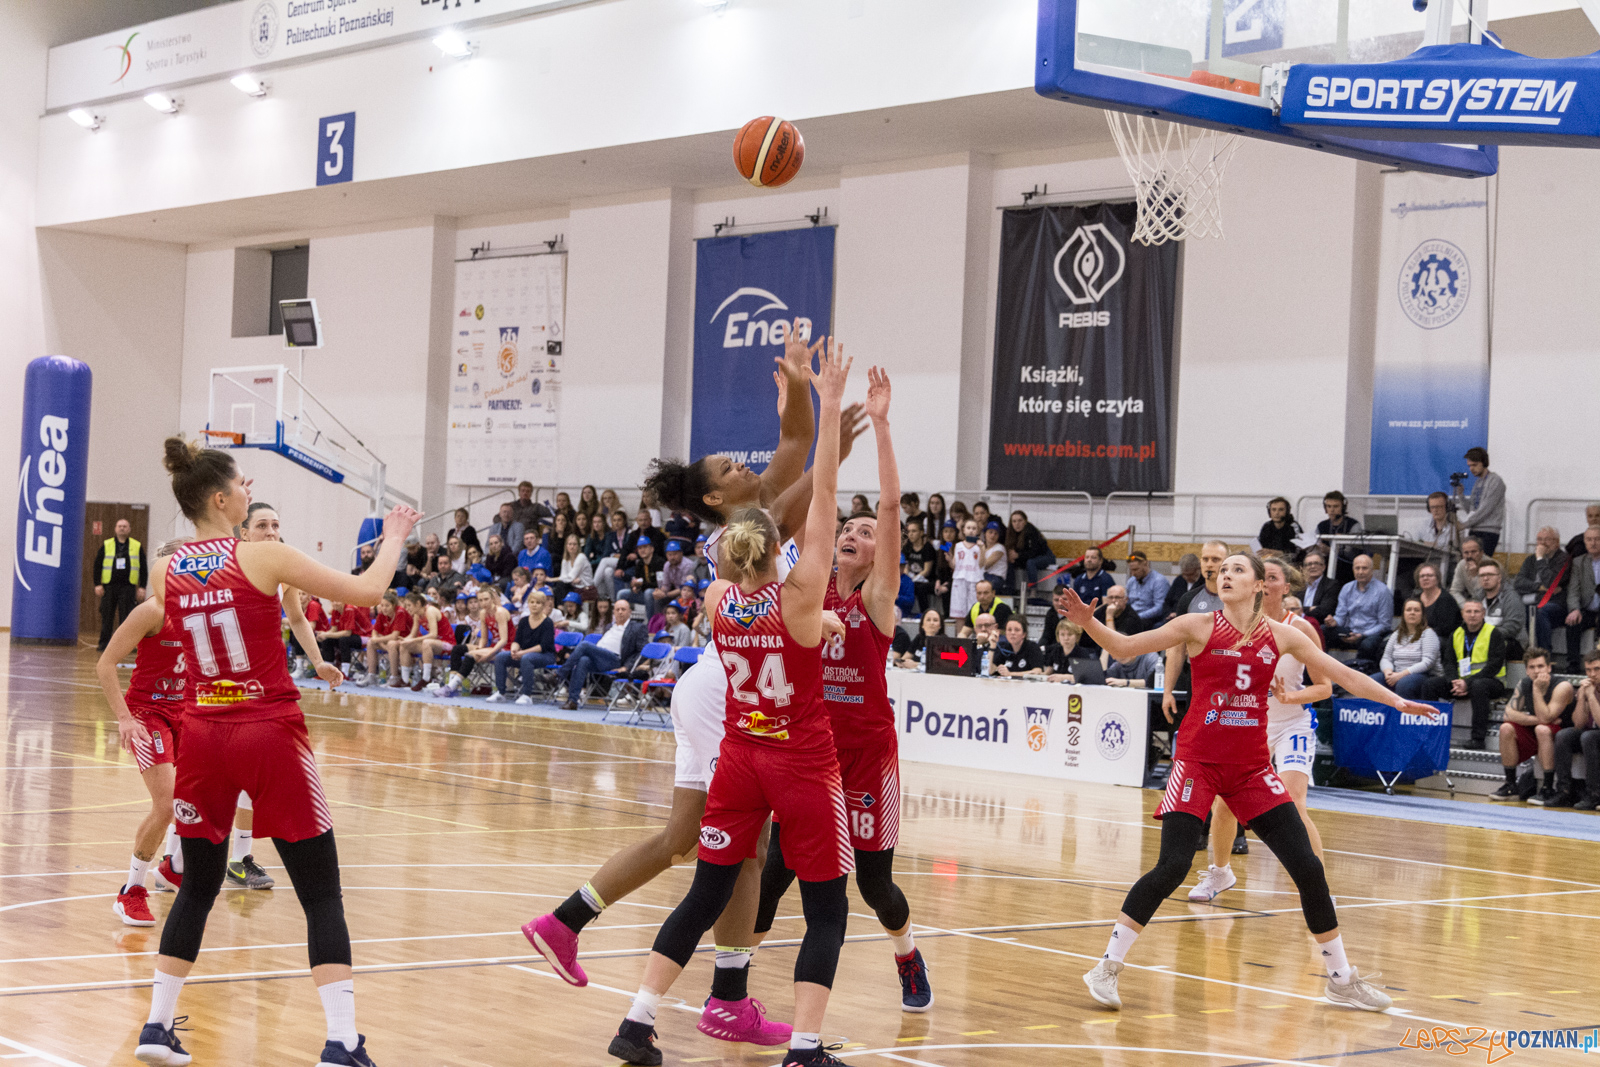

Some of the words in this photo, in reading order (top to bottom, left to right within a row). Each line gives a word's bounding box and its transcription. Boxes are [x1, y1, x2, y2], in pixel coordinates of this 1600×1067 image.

[287, 0, 325, 18] Centrum
[286, 17, 336, 45] Politechniki
[338, 8, 394, 34] Poznańskiej
[1305, 76, 1577, 122] SPORTSYSTEM
[325, 120, 346, 177] 3
[769, 131, 790, 173] molten
[723, 312, 812, 349] Enea
[1059, 310, 1111, 328] REBIS
[1020, 365, 1084, 387] Książki,
[1018, 396, 1063, 413] które
[1066, 396, 1092, 417] się
[1096, 397, 1144, 418] czyta
[1003, 440, 1156, 462] www.rebis.com.pl
[24, 414, 69, 569] Enea
[179, 588, 234, 609] WAJLER
[182, 607, 251, 678] 11
[720, 650, 795, 708] 24
[1235, 664, 1252, 691] 5
[906, 700, 1009, 744] Poznań
[1221, 711, 1248, 719] POWIAT
[1339, 708, 1385, 725] molten
[1065, 747, 1081, 755] Basket
[1289, 734, 1308, 753] 11
[1262, 773, 1285, 795] 5
[850, 810, 875, 840] 18
